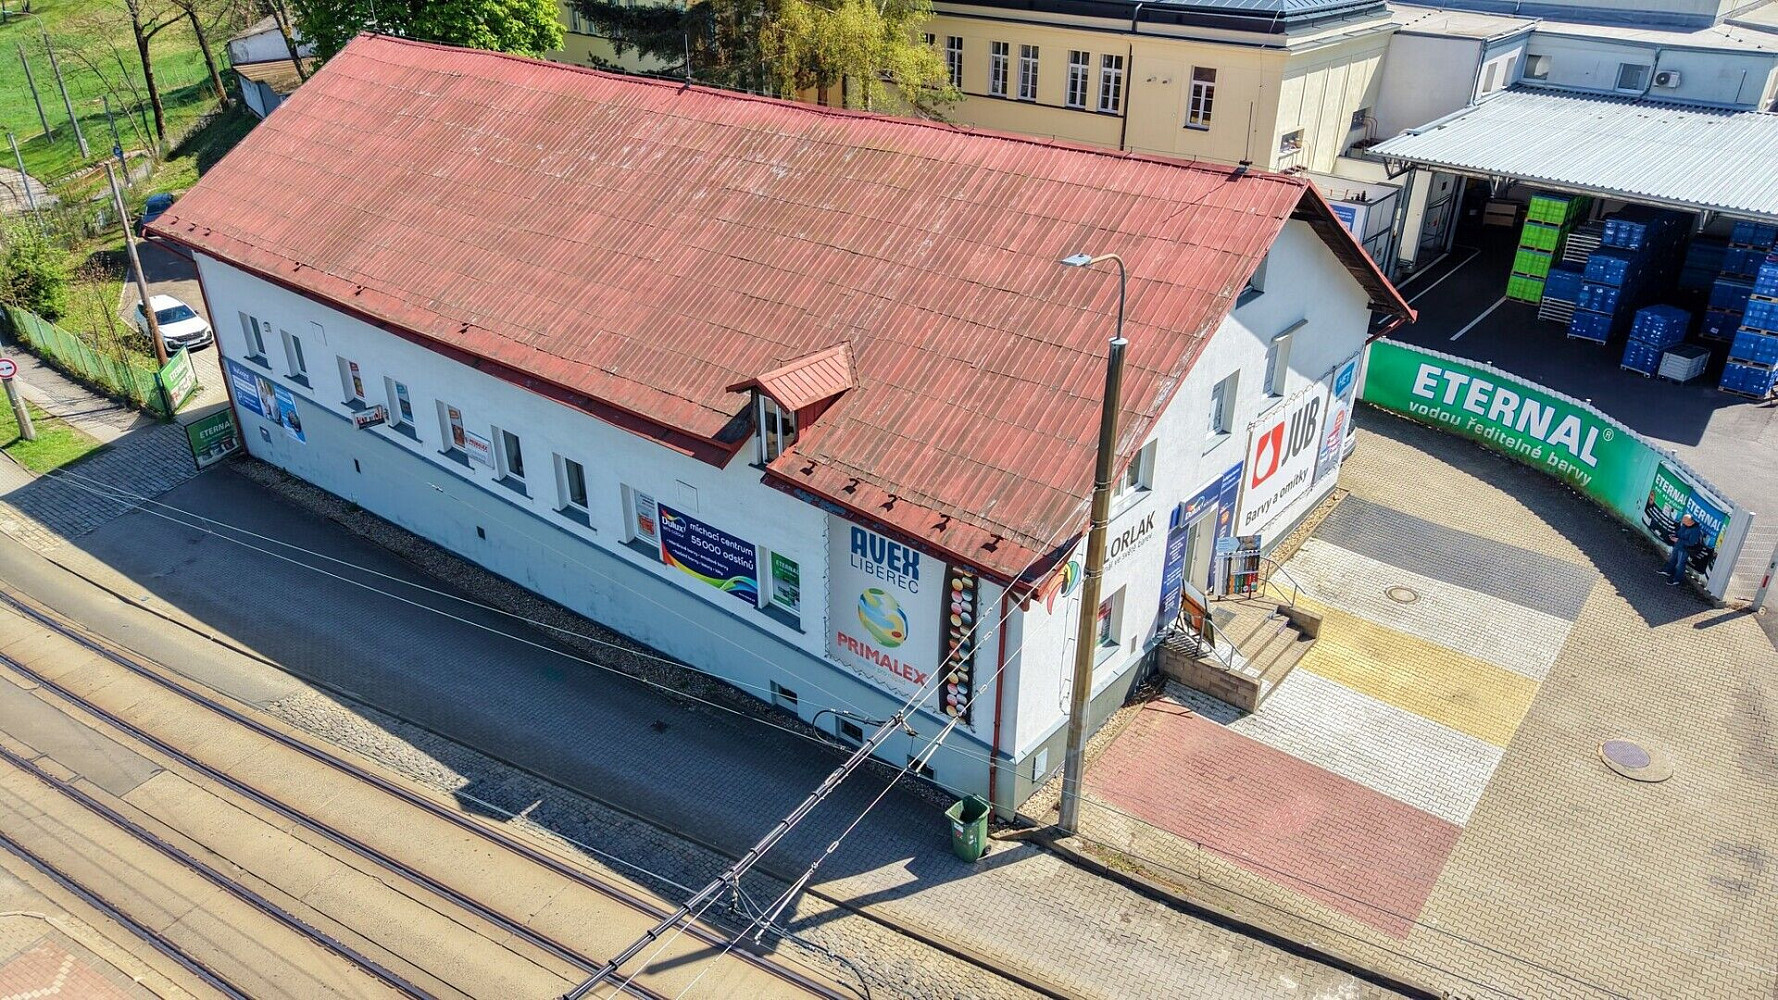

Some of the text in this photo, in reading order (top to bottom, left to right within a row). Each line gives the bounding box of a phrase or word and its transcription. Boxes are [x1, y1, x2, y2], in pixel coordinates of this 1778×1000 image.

[1281, 396, 1320, 467] JUB
[1412, 363, 1600, 468] ETERNAL
[1409, 401, 1592, 486] vodou ředitelné barvy
[1245, 497, 1271, 526] Barvy
[1272, 493, 1278, 503] a
[720, 537, 753, 557] centrum
[851, 525, 919, 580] AVEX
[1104, 510, 1156, 565] LORLAK
[851, 554, 918, 594] LIBEREC
[837, 631, 927, 687] PRIMALEX
